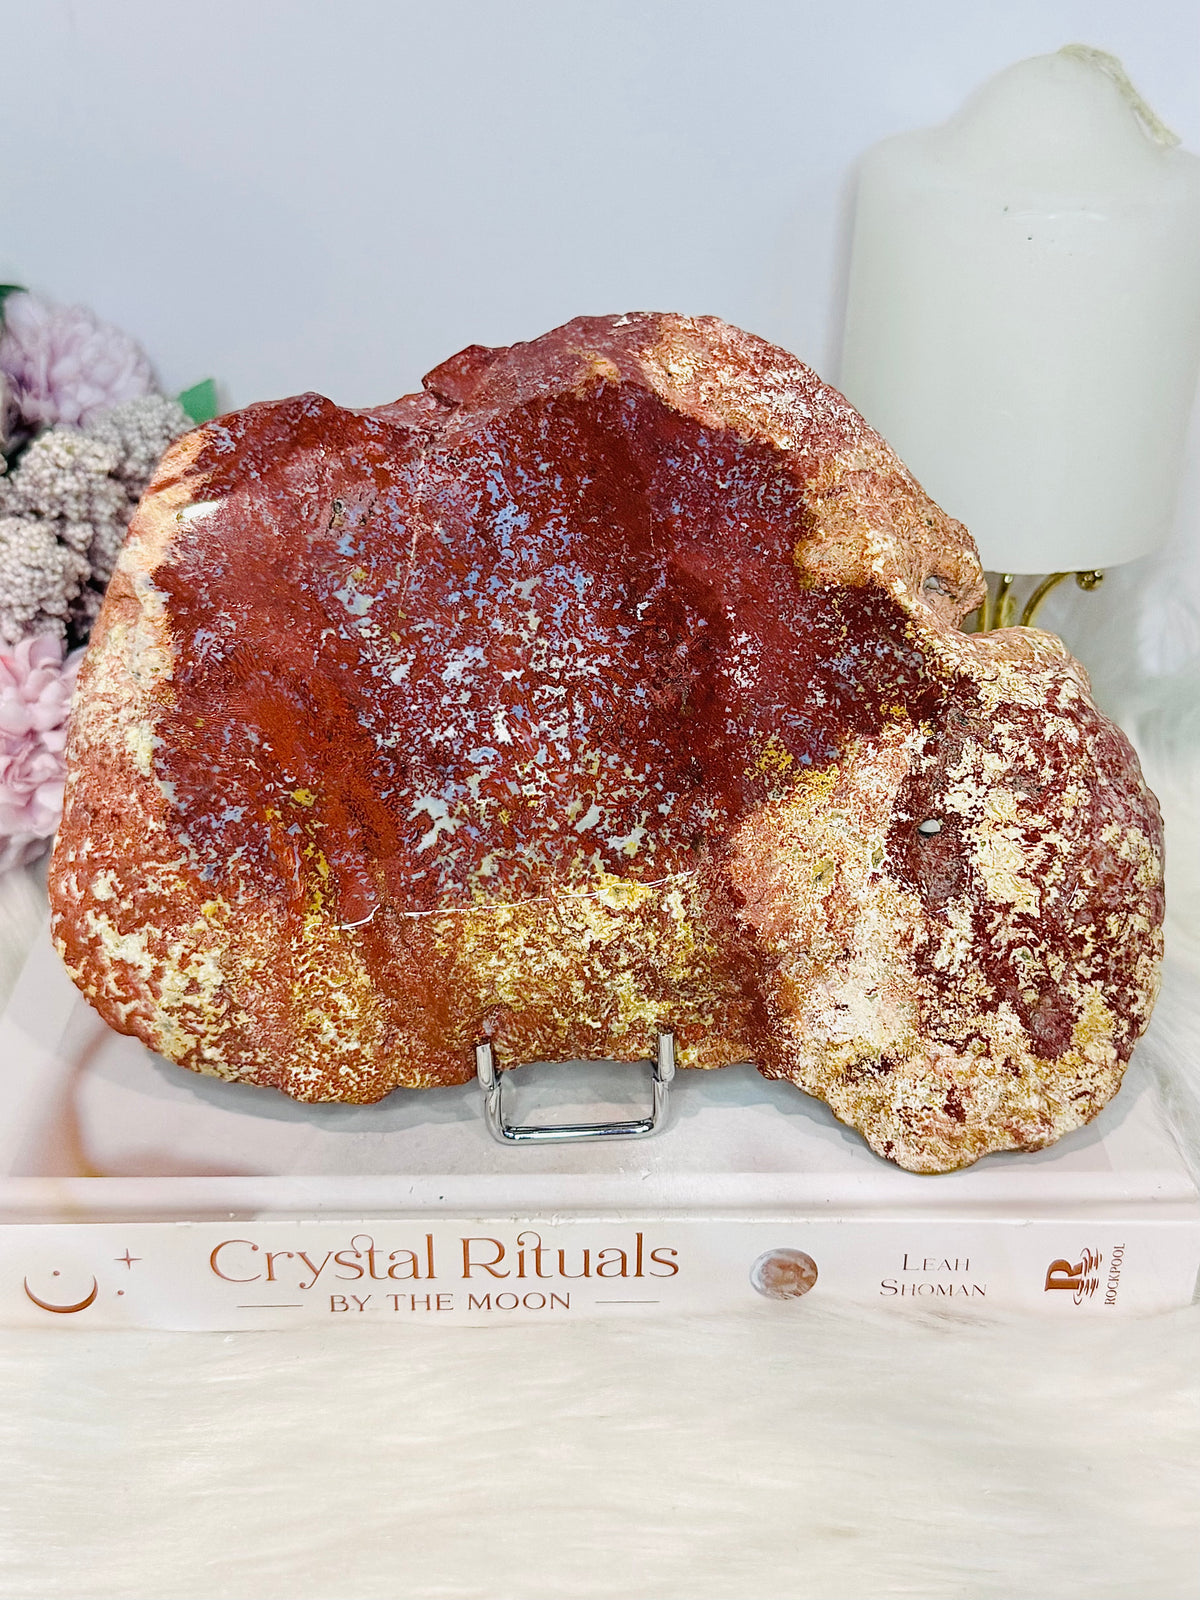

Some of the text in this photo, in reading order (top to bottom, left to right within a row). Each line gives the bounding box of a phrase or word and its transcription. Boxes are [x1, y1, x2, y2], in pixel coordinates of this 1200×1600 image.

[210, 1230, 680, 1290] Crystal Rituals
[1105, 1242, 1125, 1305] ROCKPOOL
[330, 1291, 570, 1313] BY THE MOON
